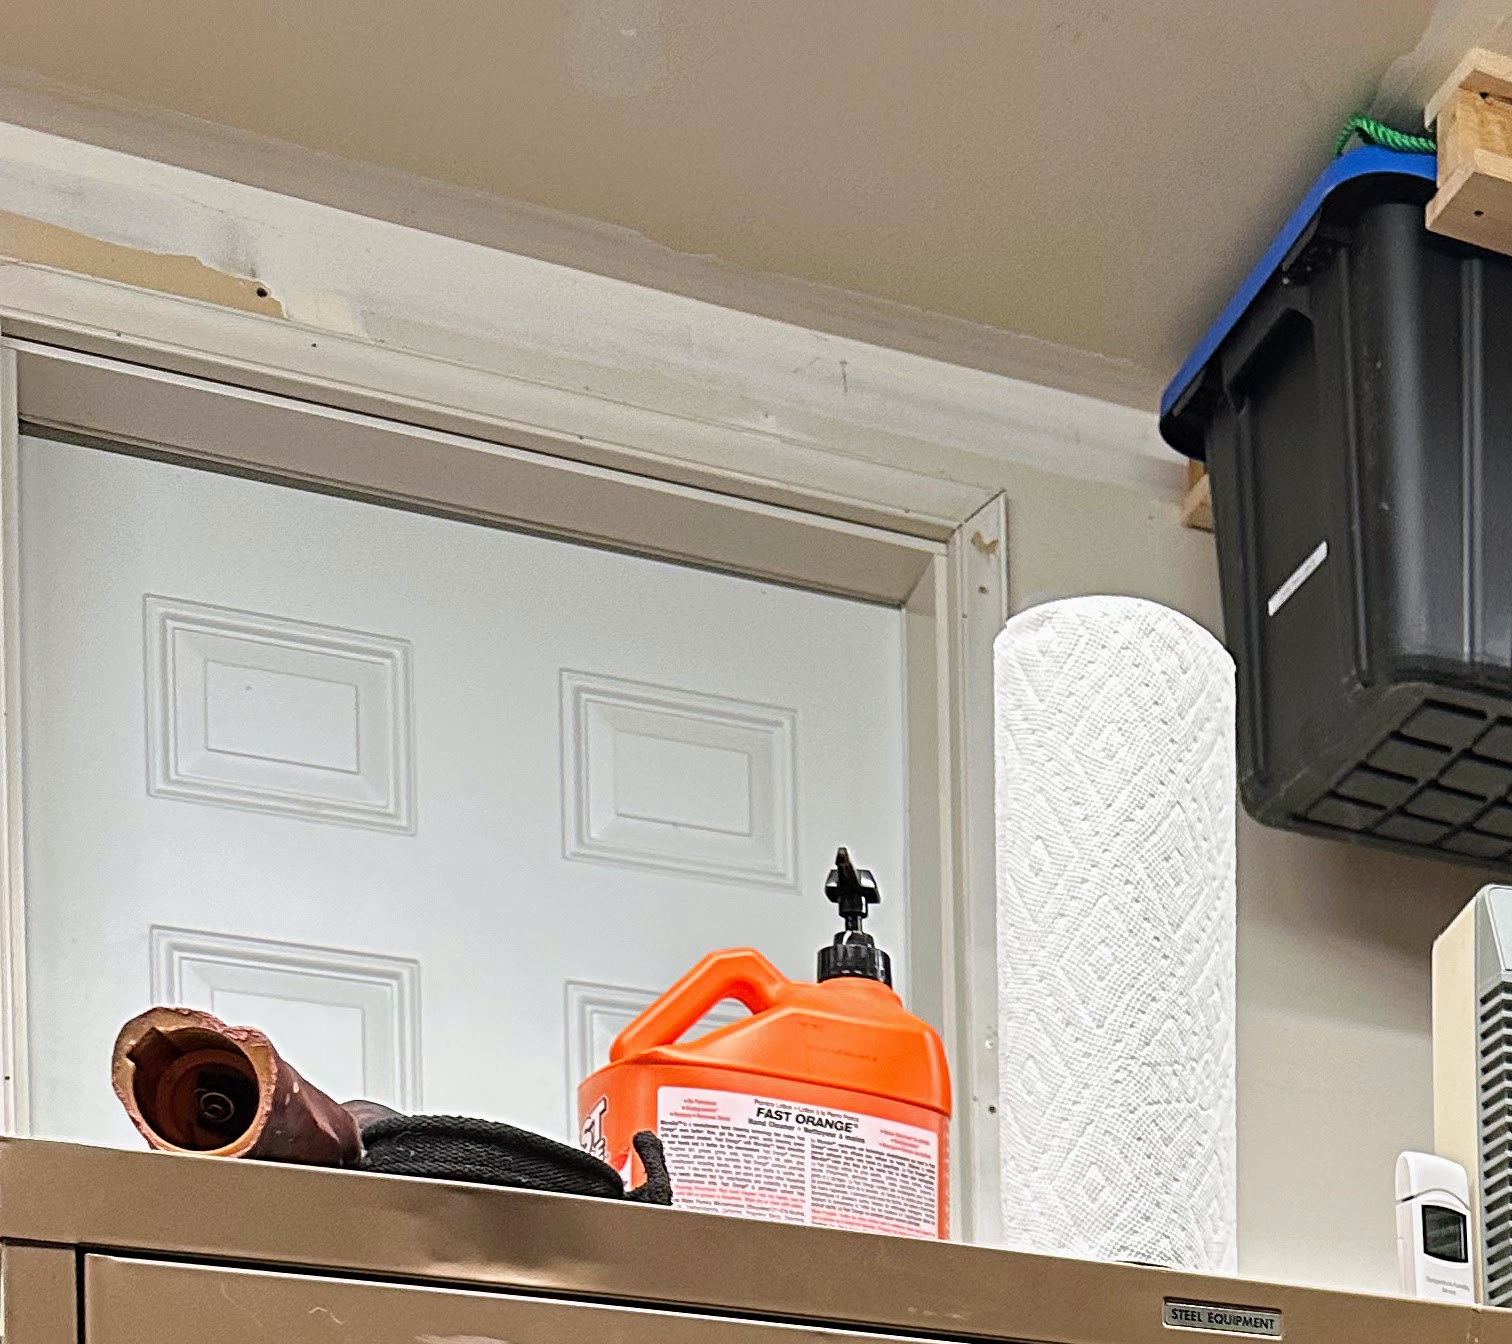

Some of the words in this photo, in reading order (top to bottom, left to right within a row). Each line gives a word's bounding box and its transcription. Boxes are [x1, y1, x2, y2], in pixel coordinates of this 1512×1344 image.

[756, 1107, 792, 1122] FAST
[1171, 1308, 1203, 1323] STEEL
[1207, 1312, 1276, 1330] EQUIPMENT
